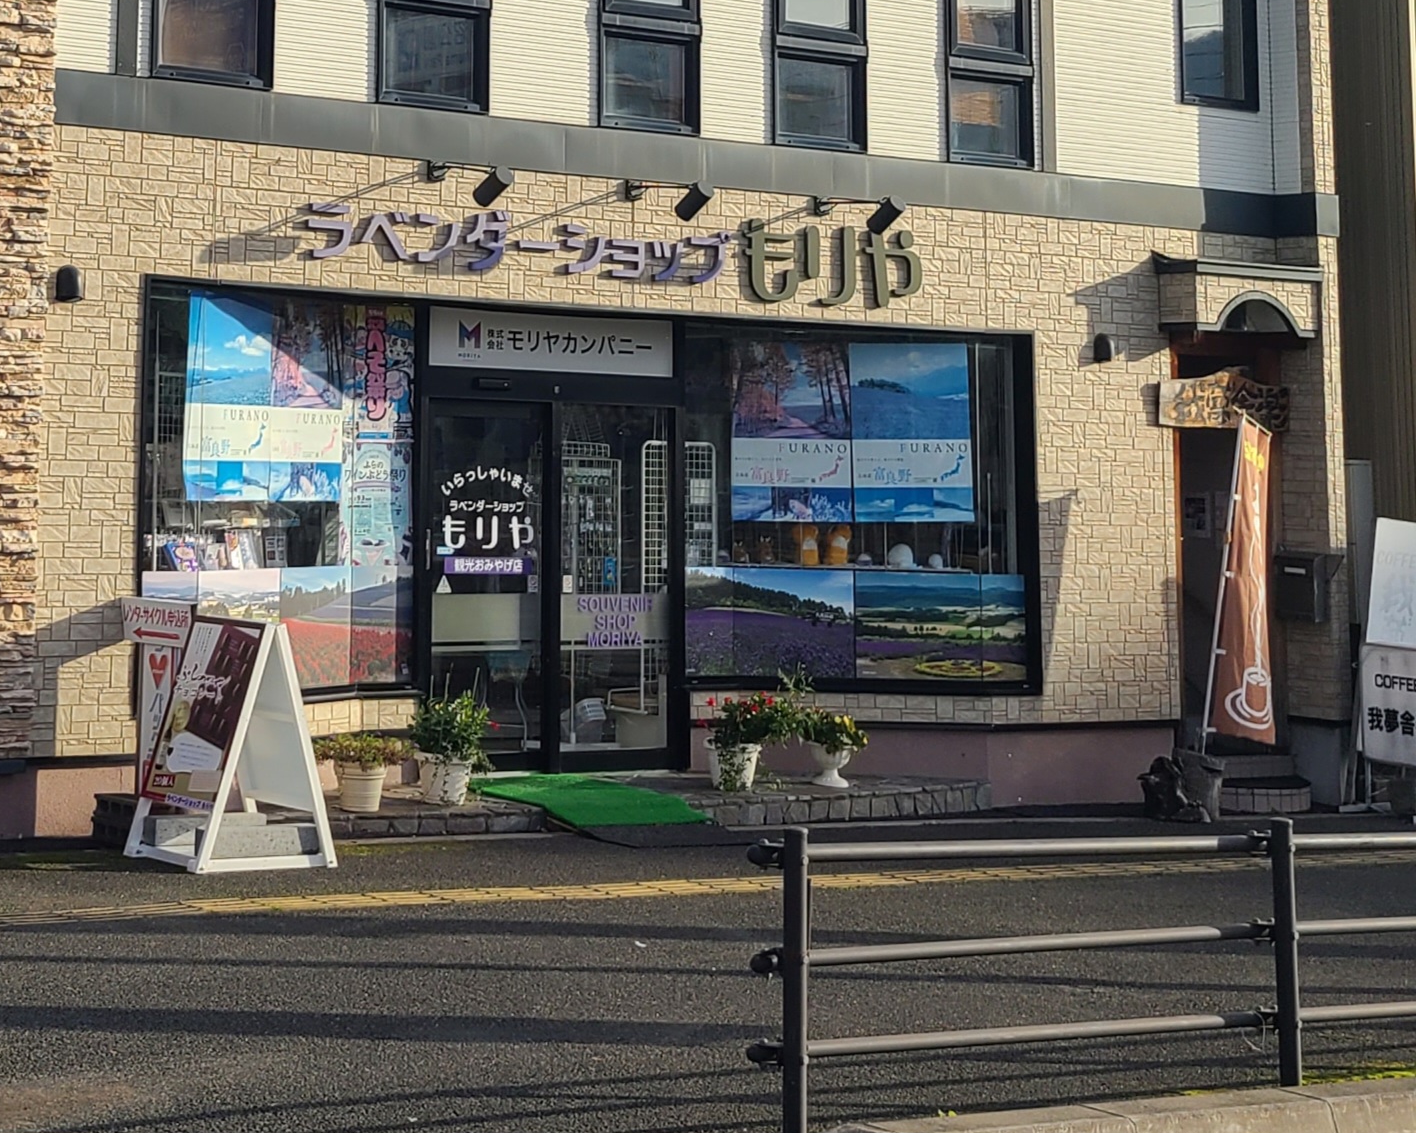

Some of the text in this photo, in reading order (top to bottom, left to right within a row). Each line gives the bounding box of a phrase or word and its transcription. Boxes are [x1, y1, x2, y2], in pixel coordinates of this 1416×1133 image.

[306, 202, 923, 309] ラベンダーショップ もりや
[507, 330, 653, 355] モリヤカンパニー
[224, 409, 269, 421] FURANO
[296, 413, 341, 425] FURANO
[778, 443, 848, 454] FURANO
[900, 443, 968, 453] FURANO
[441, 466, 533, 498] いらっしゃいませ
[449, 500, 525, 513] ラベンダーショップ
[442, 515, 534, 550] もりや
[454, 558, 524, 572] 観光おみやげ店
[577, 596, 653, 612] SOUVENIR
[594, 614, 636, 629] SHOP
[587, 631, 644, 647] MORIYA
